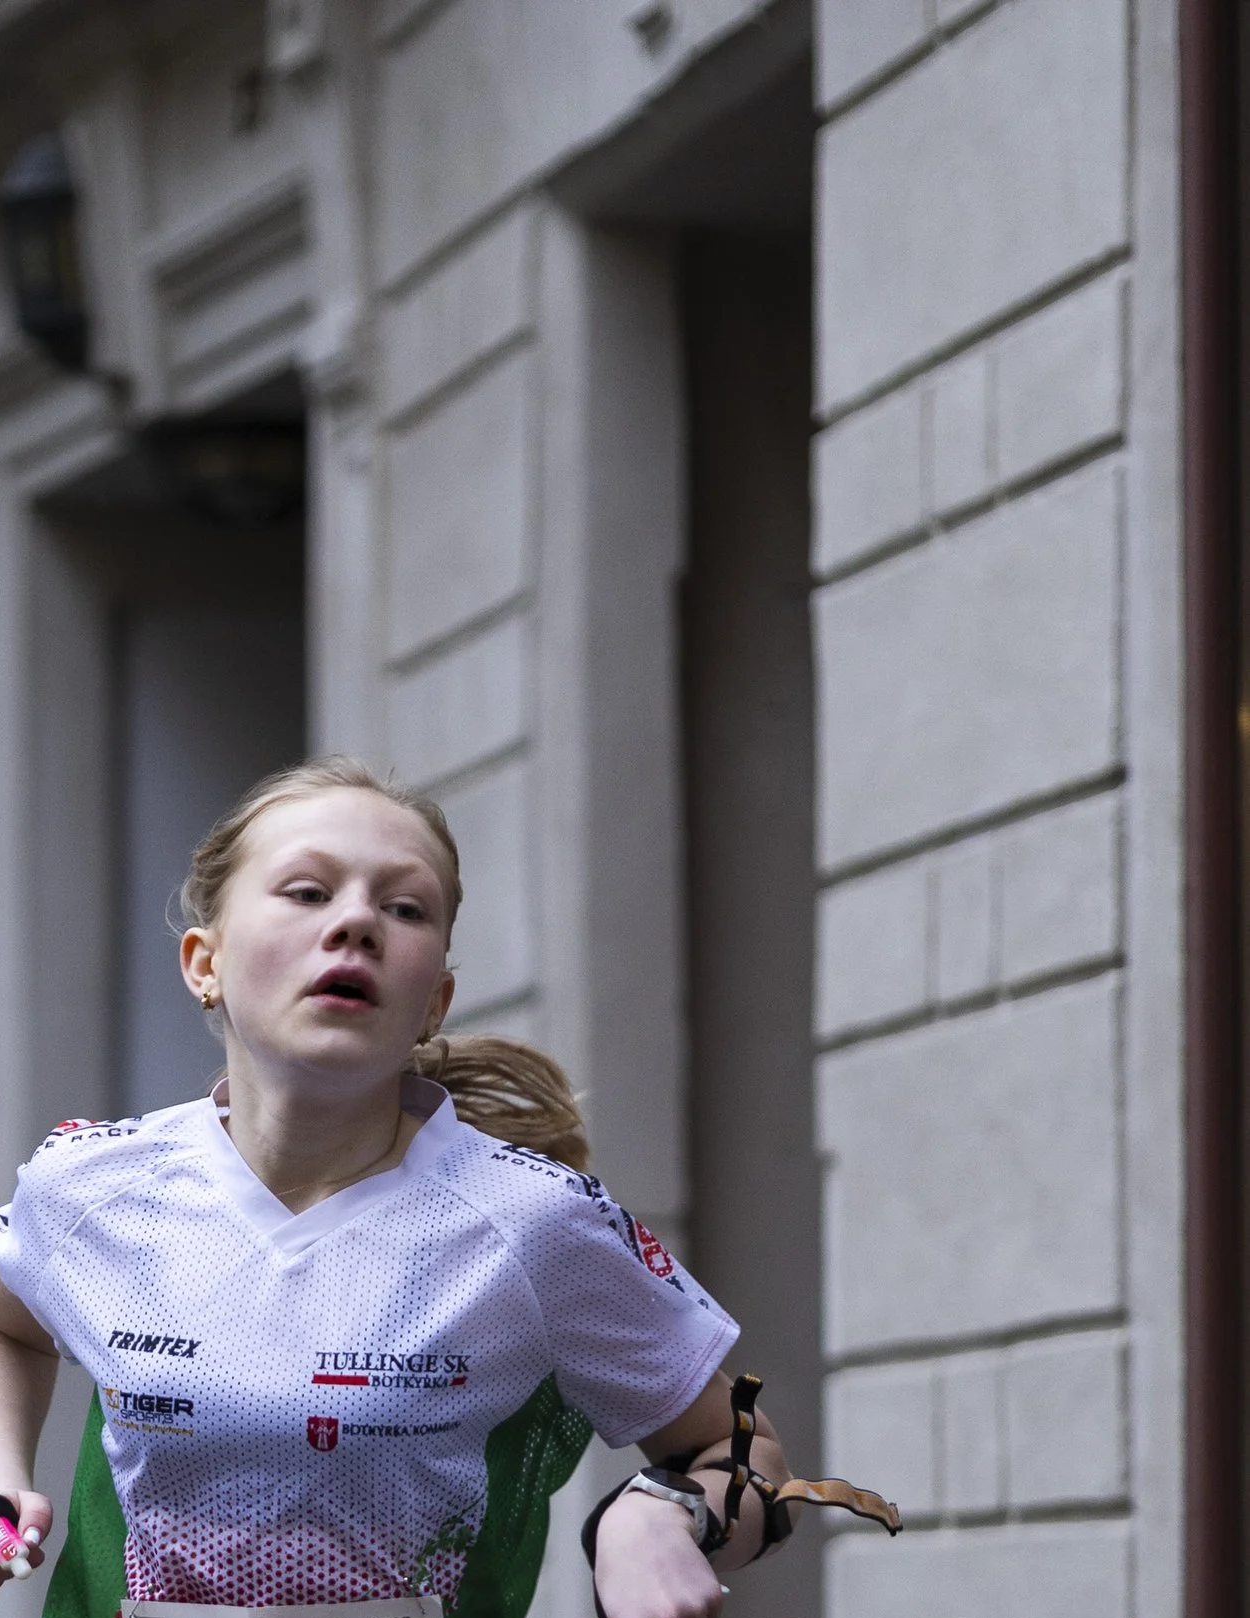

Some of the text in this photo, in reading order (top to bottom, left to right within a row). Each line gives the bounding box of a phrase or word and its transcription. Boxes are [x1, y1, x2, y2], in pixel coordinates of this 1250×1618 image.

[107, 1330, 202, 1358] TRIMTEX
[316, 1351, 471, 1373] TULLINGE SK
[371, 1375, 448, 1388] BOTKYRKA
[120, 1390, 195, 1417] TIGER
[120, 1408, 174, 1425] SPORTS
